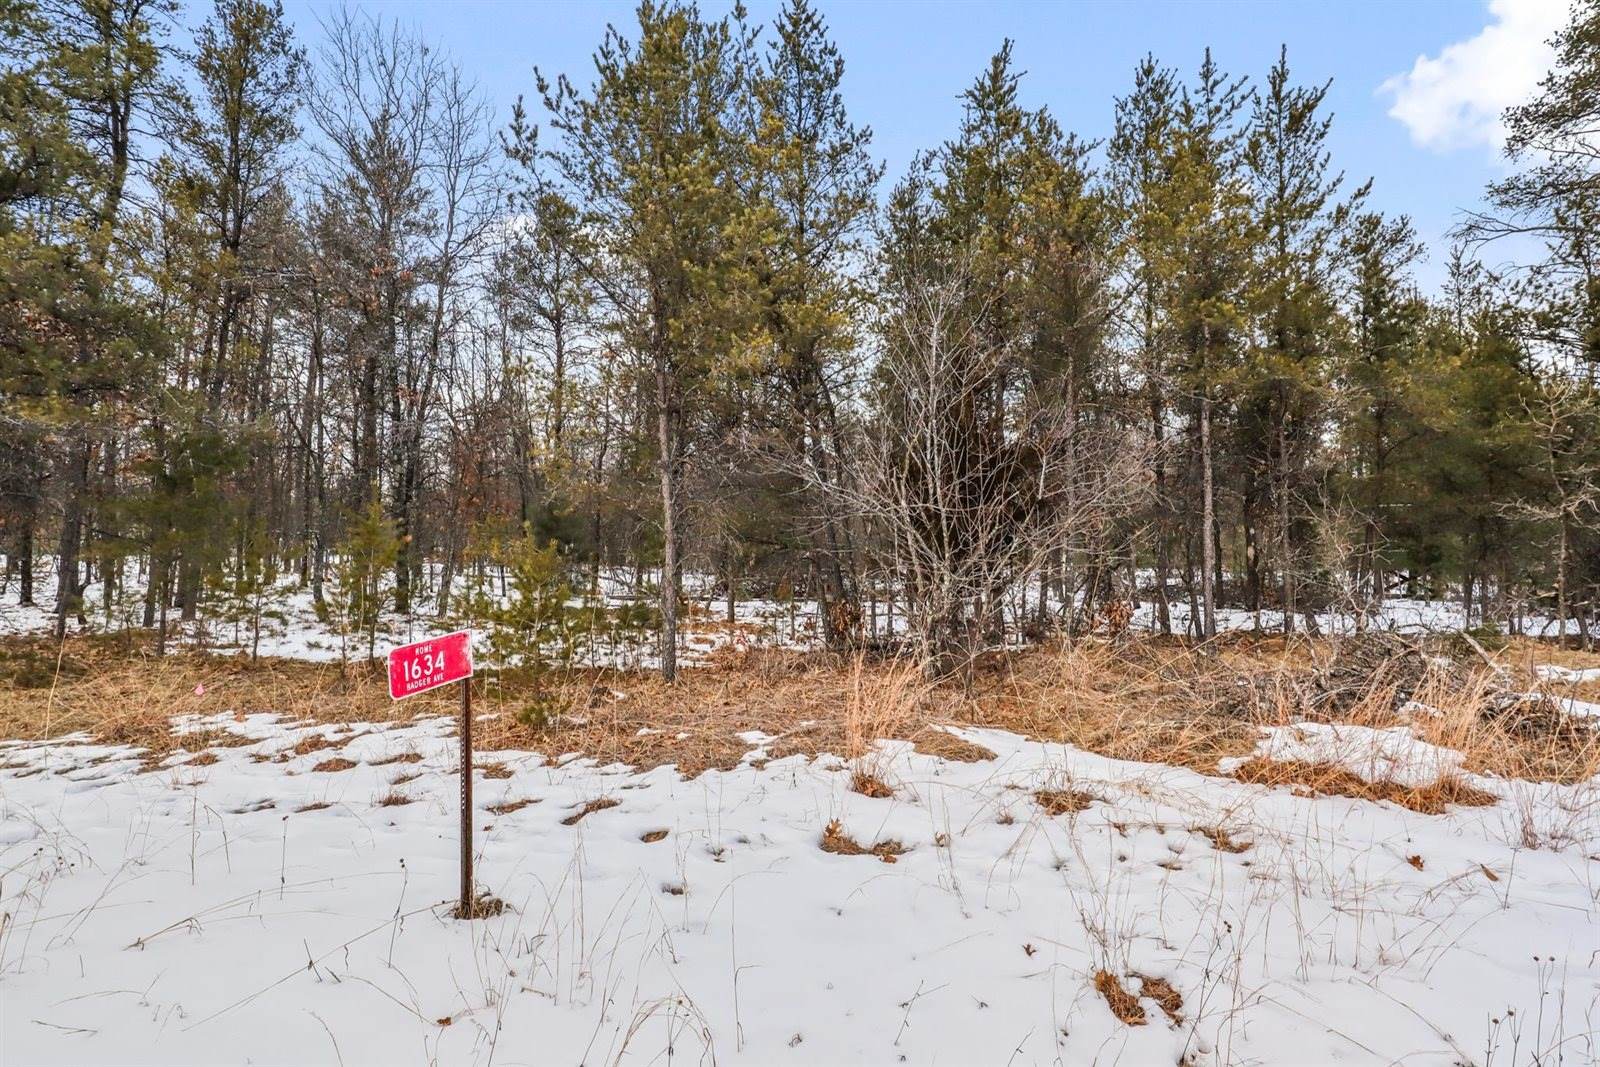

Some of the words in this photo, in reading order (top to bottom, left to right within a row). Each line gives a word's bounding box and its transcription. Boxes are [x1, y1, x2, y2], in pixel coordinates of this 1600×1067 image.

[403, 650, 445, 681] 1634
[406, 677, 431, 691] BADGER
[434, 673, 444, 683] AVE
